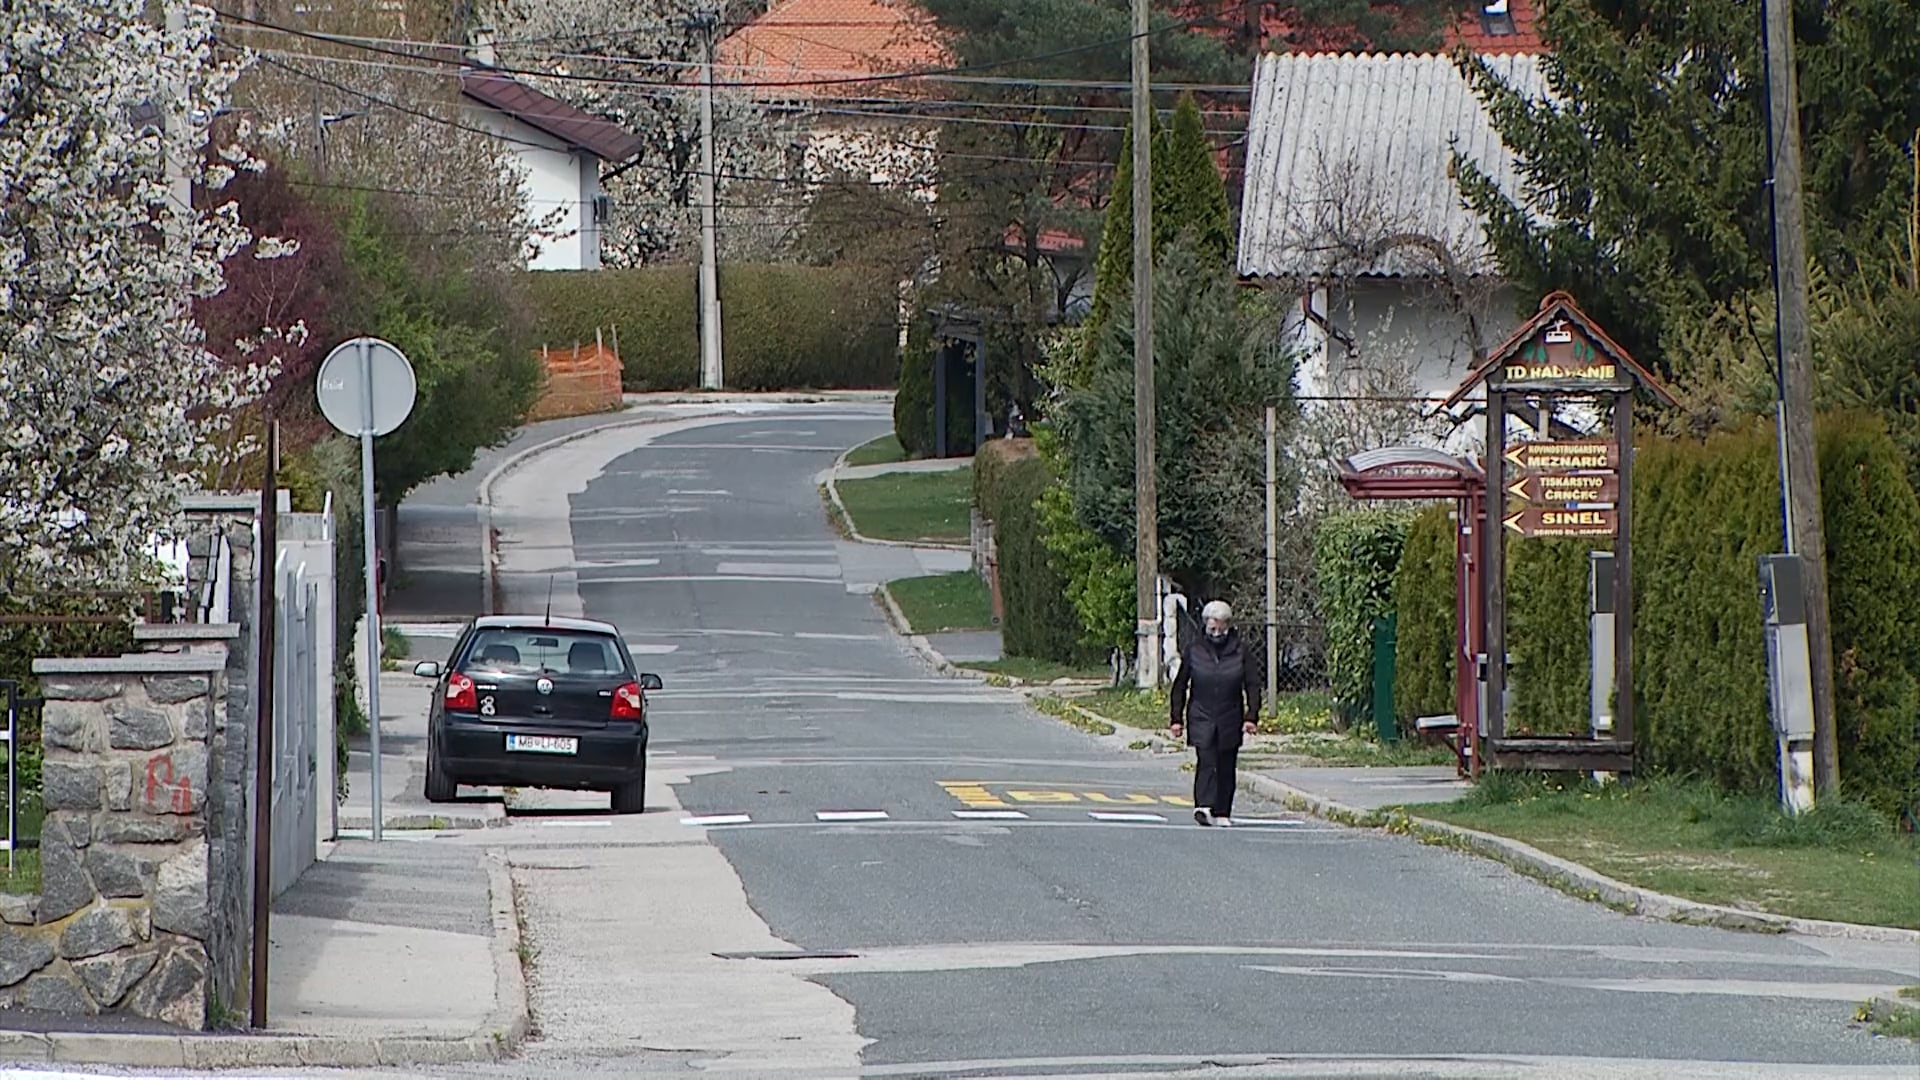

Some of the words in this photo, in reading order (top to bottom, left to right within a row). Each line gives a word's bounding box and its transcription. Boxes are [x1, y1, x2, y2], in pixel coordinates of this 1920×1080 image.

[1505, 365, 1527, 379] TD
[1540, 477, 1603, 487] TISKARSTVO
[1541, 511, 1606, 524] SINEL
